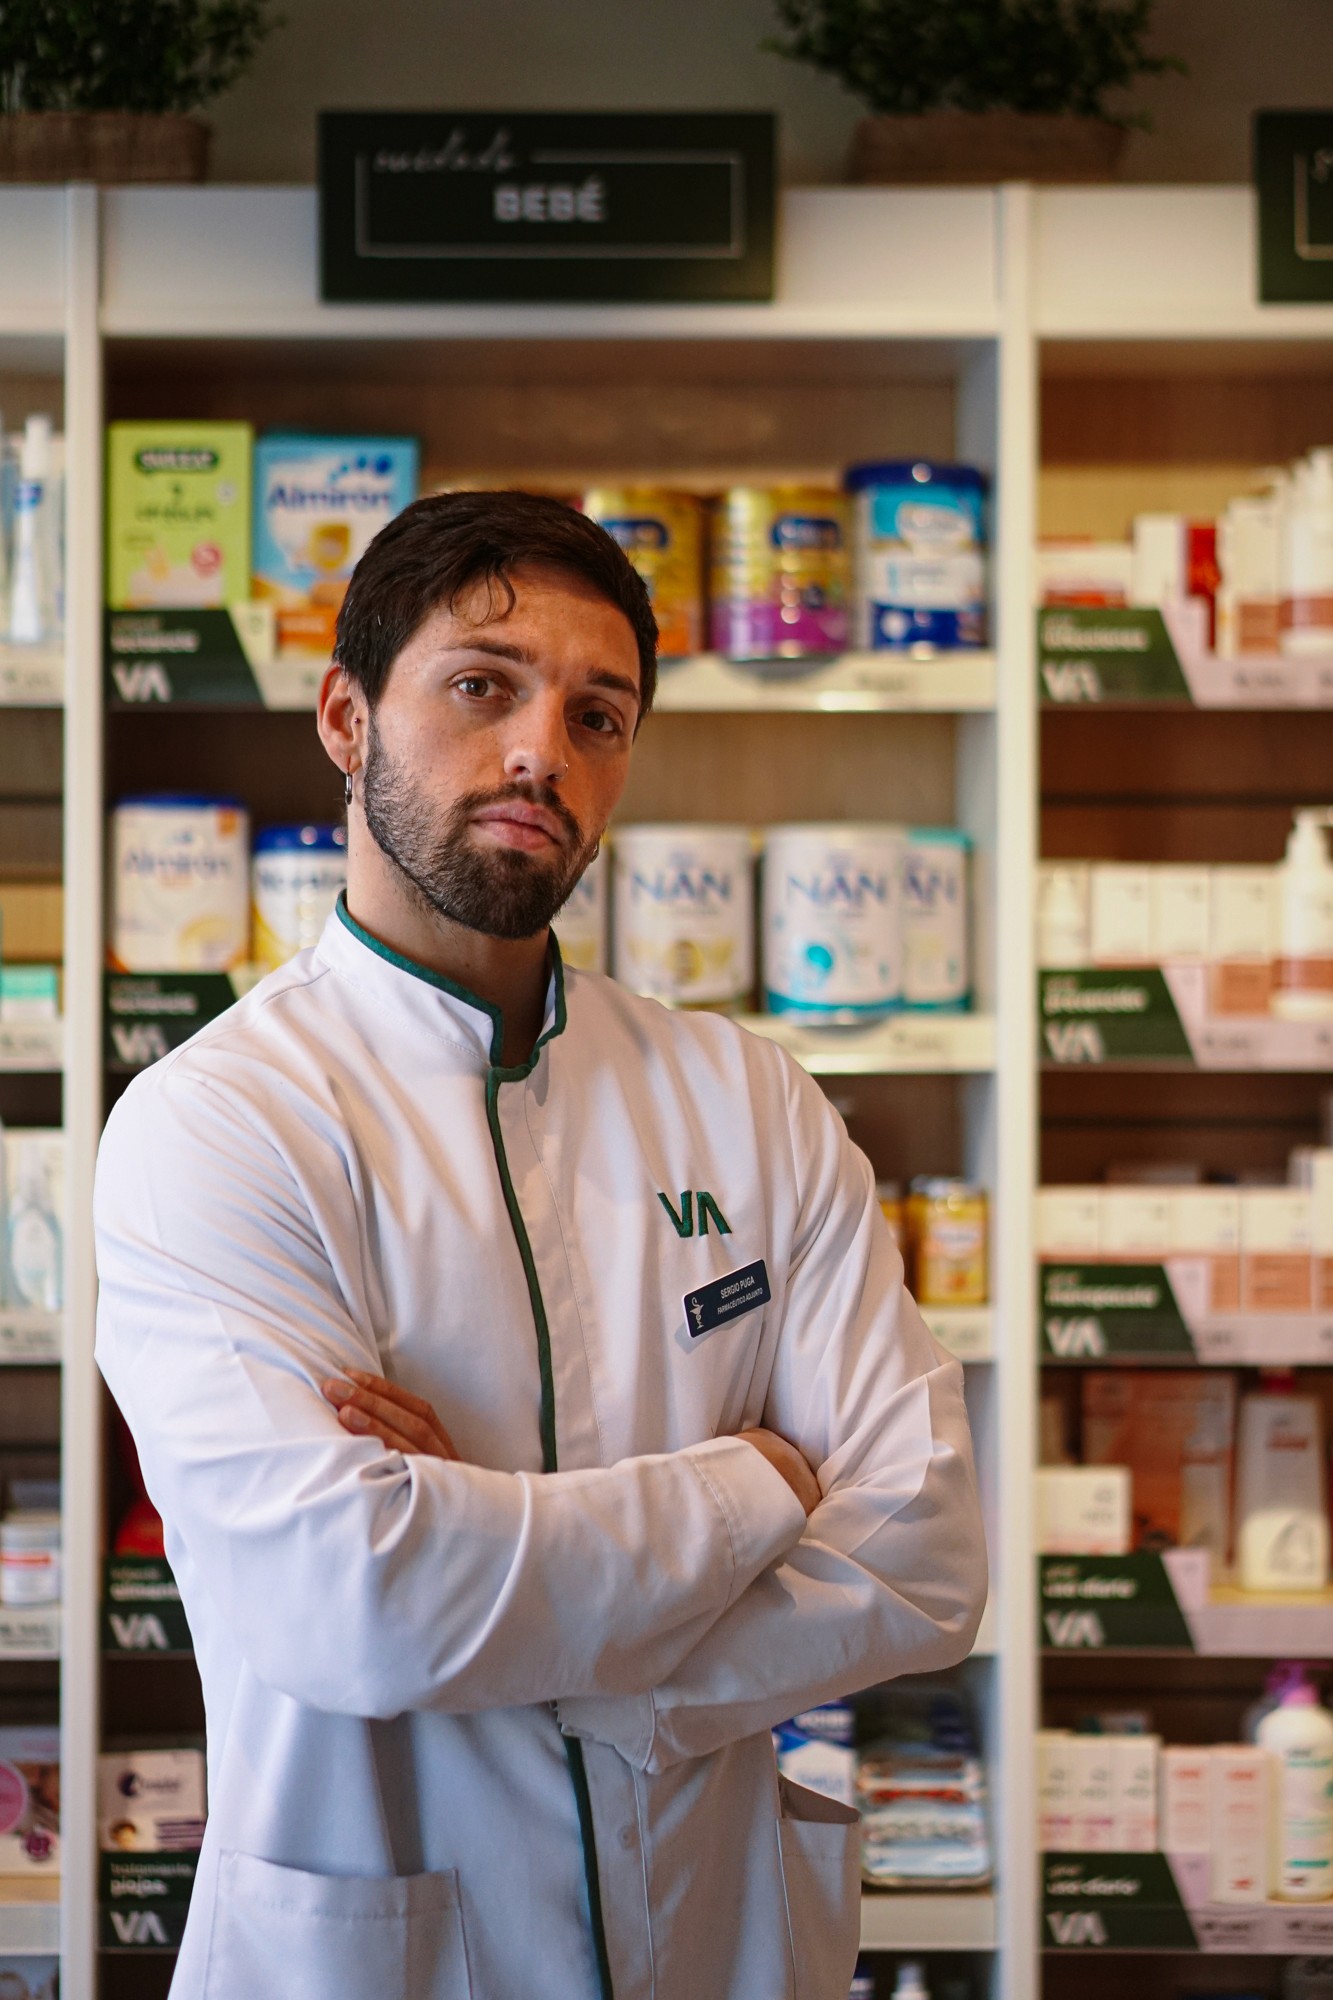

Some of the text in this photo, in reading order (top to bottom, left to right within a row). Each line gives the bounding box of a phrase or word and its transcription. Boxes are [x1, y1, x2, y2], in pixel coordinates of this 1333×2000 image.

[494, 175, 605, 222] BEBÉ
[657, 1190, 733, 1238] VA
[720, 1275, 755, 1299] SERGIO PUGA
[745, 1287, 763, 1302] ADJUNTO
[110, 1877, 168, 1898] piojos
[110, 1911, 169, 1945] VA
